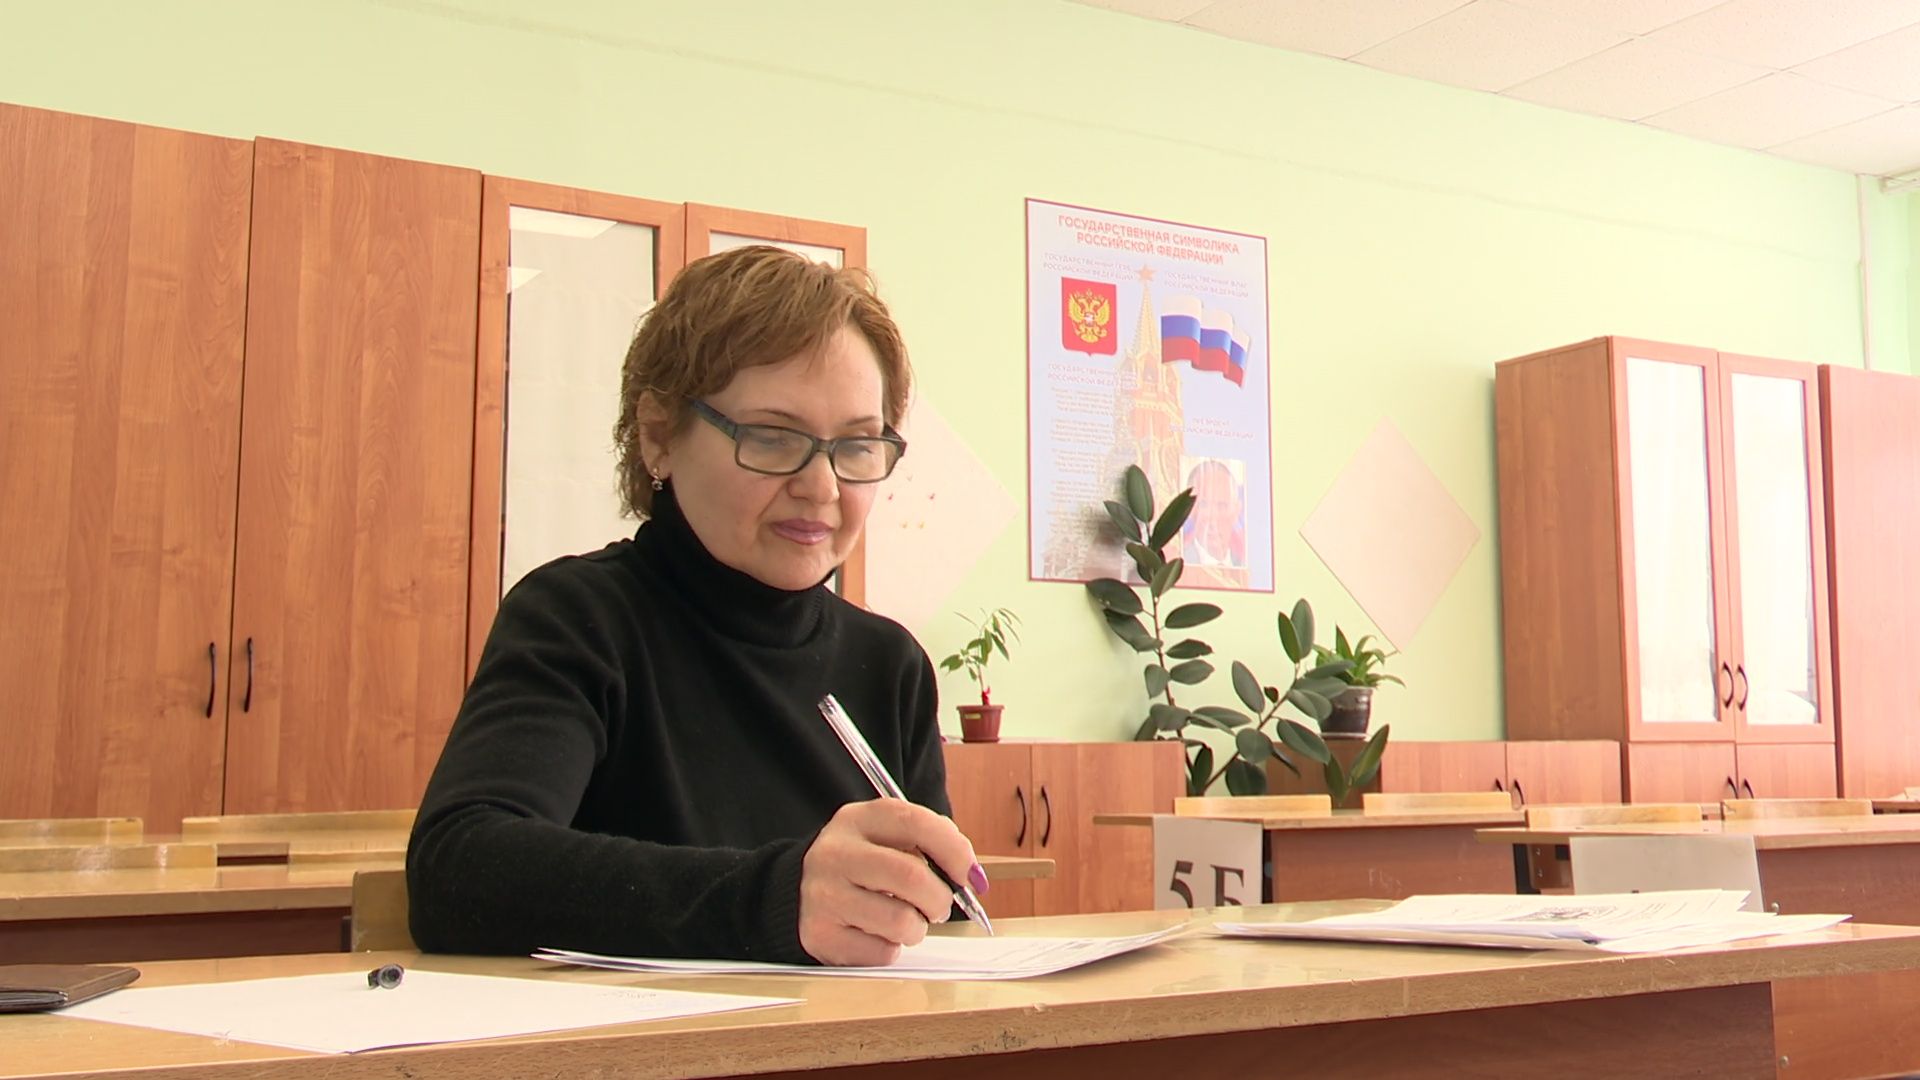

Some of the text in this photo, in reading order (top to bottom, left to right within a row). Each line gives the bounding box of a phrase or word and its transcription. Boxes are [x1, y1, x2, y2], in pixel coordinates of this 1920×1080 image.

[1058, 215, 1240, 254] ГОСУДАРСТВЕННАЯ СИМВОЛИКА
[1077, 231, 1224, 265] РОССИЙСКОЙ ФЕДЕРАЦИИ
